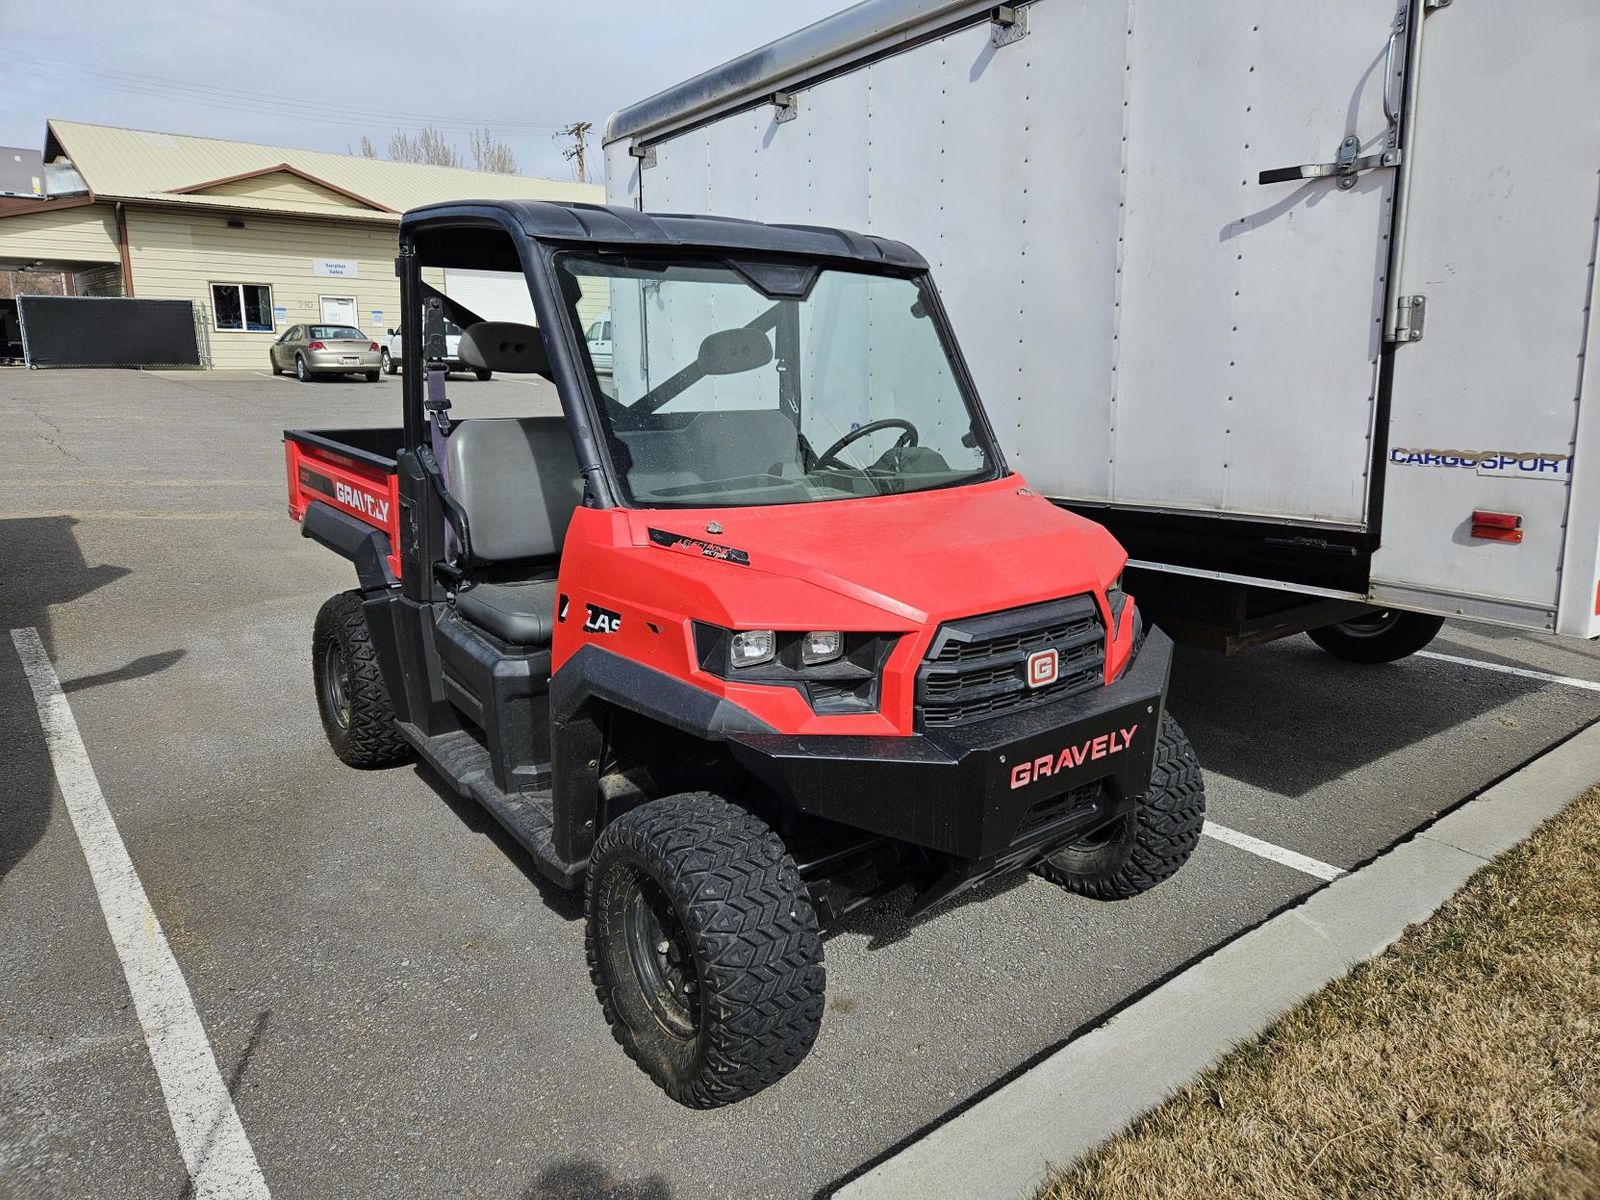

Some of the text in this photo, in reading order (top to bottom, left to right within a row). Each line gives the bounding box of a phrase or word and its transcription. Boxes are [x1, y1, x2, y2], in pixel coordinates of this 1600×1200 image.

[325, 262, 346, 270] Surplus
[336, 481, 390, 523] GRAVELY
[1028, 649, 1059, 687] G
[1010, 724, 1138, 790] GRAVELY
